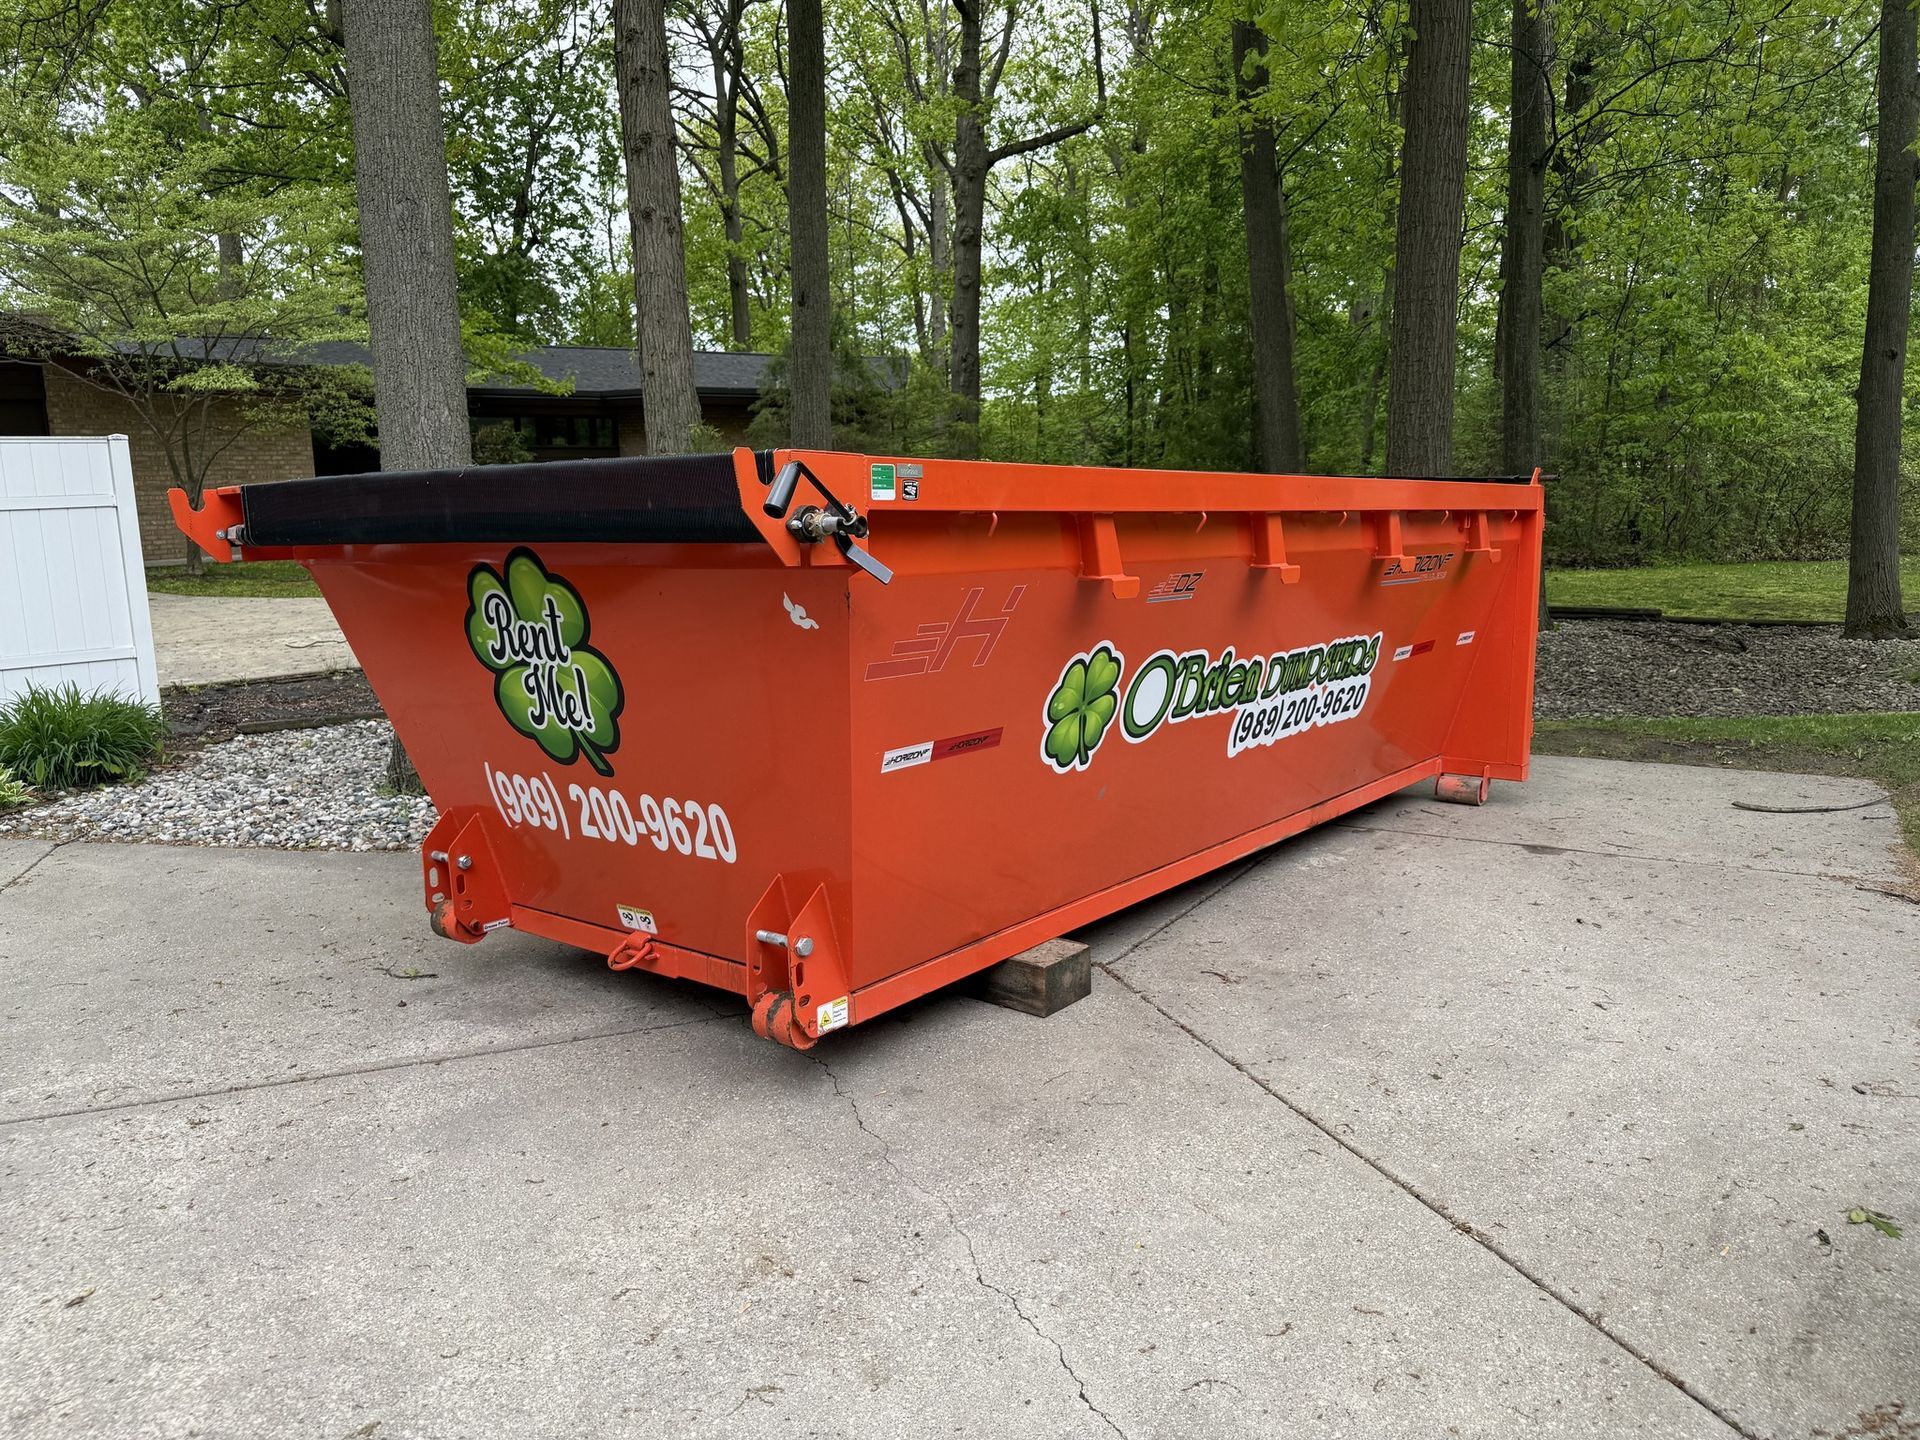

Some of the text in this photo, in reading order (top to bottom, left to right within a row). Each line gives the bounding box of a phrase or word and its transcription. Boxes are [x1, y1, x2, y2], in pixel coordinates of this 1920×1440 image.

[483, 591, 570, 664] Rent
[523, 663, 596, 731] Me!
[1124, 635, 1381, 739] O'Brien DUMPSTERS
[884, 735, 990, 766] HORIZON HORIZON
[484, 761, 737, 864] (989) 200-9620
